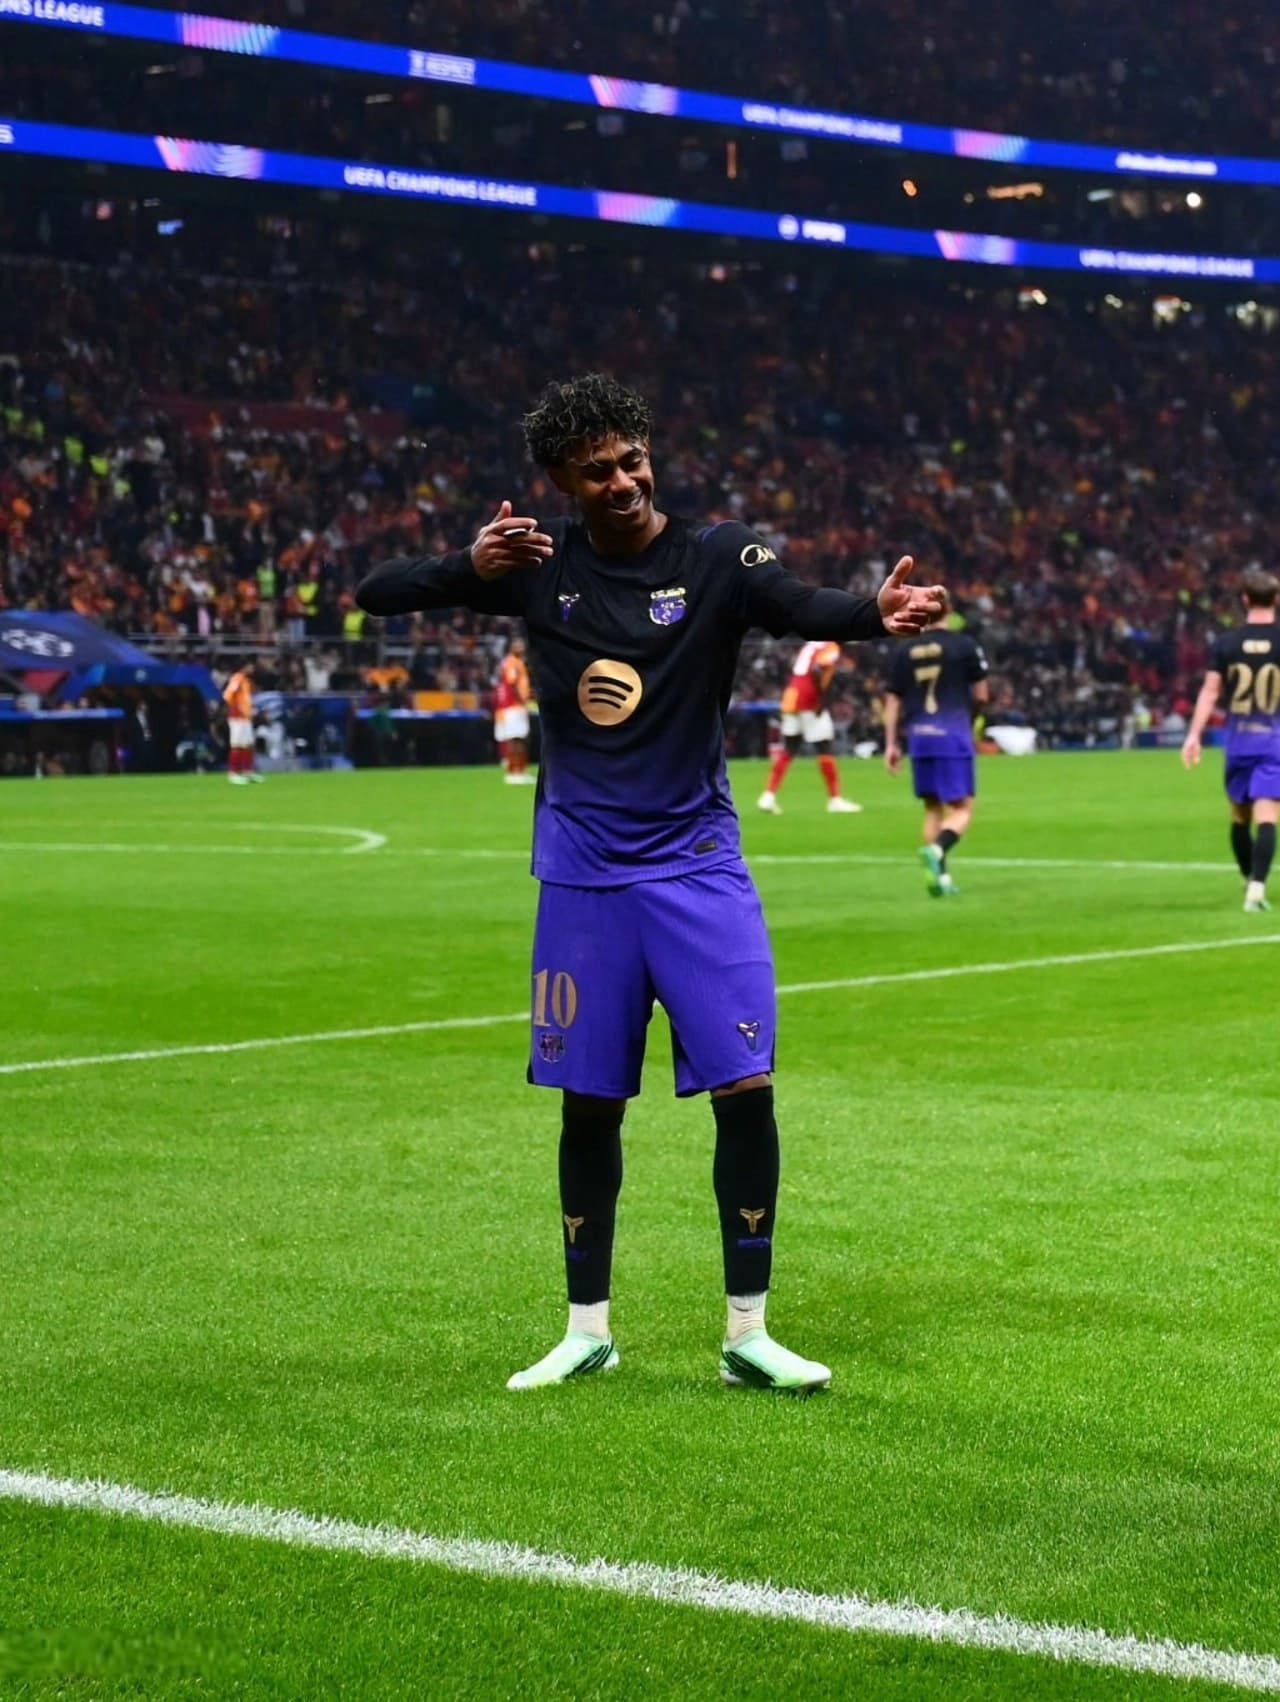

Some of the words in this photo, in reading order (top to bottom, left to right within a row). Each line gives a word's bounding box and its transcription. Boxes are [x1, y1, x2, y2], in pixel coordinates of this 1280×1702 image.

[34, 0, 104, 26] LEAGUE
[344, 166, 386, 188] UEFA
[386, 170, 478, 199] CHAMPIONS
[478, 182, 537, 206] LEAGUE
[1080, 249, 1115, 268] UEFA
[1116, 251, 1198, 274] CHAMPIONS
[1199, 256, 1254, 277] LEAGUE
[914, 665, 942, 715] 7
[534, 968, 577, 1028] 10
